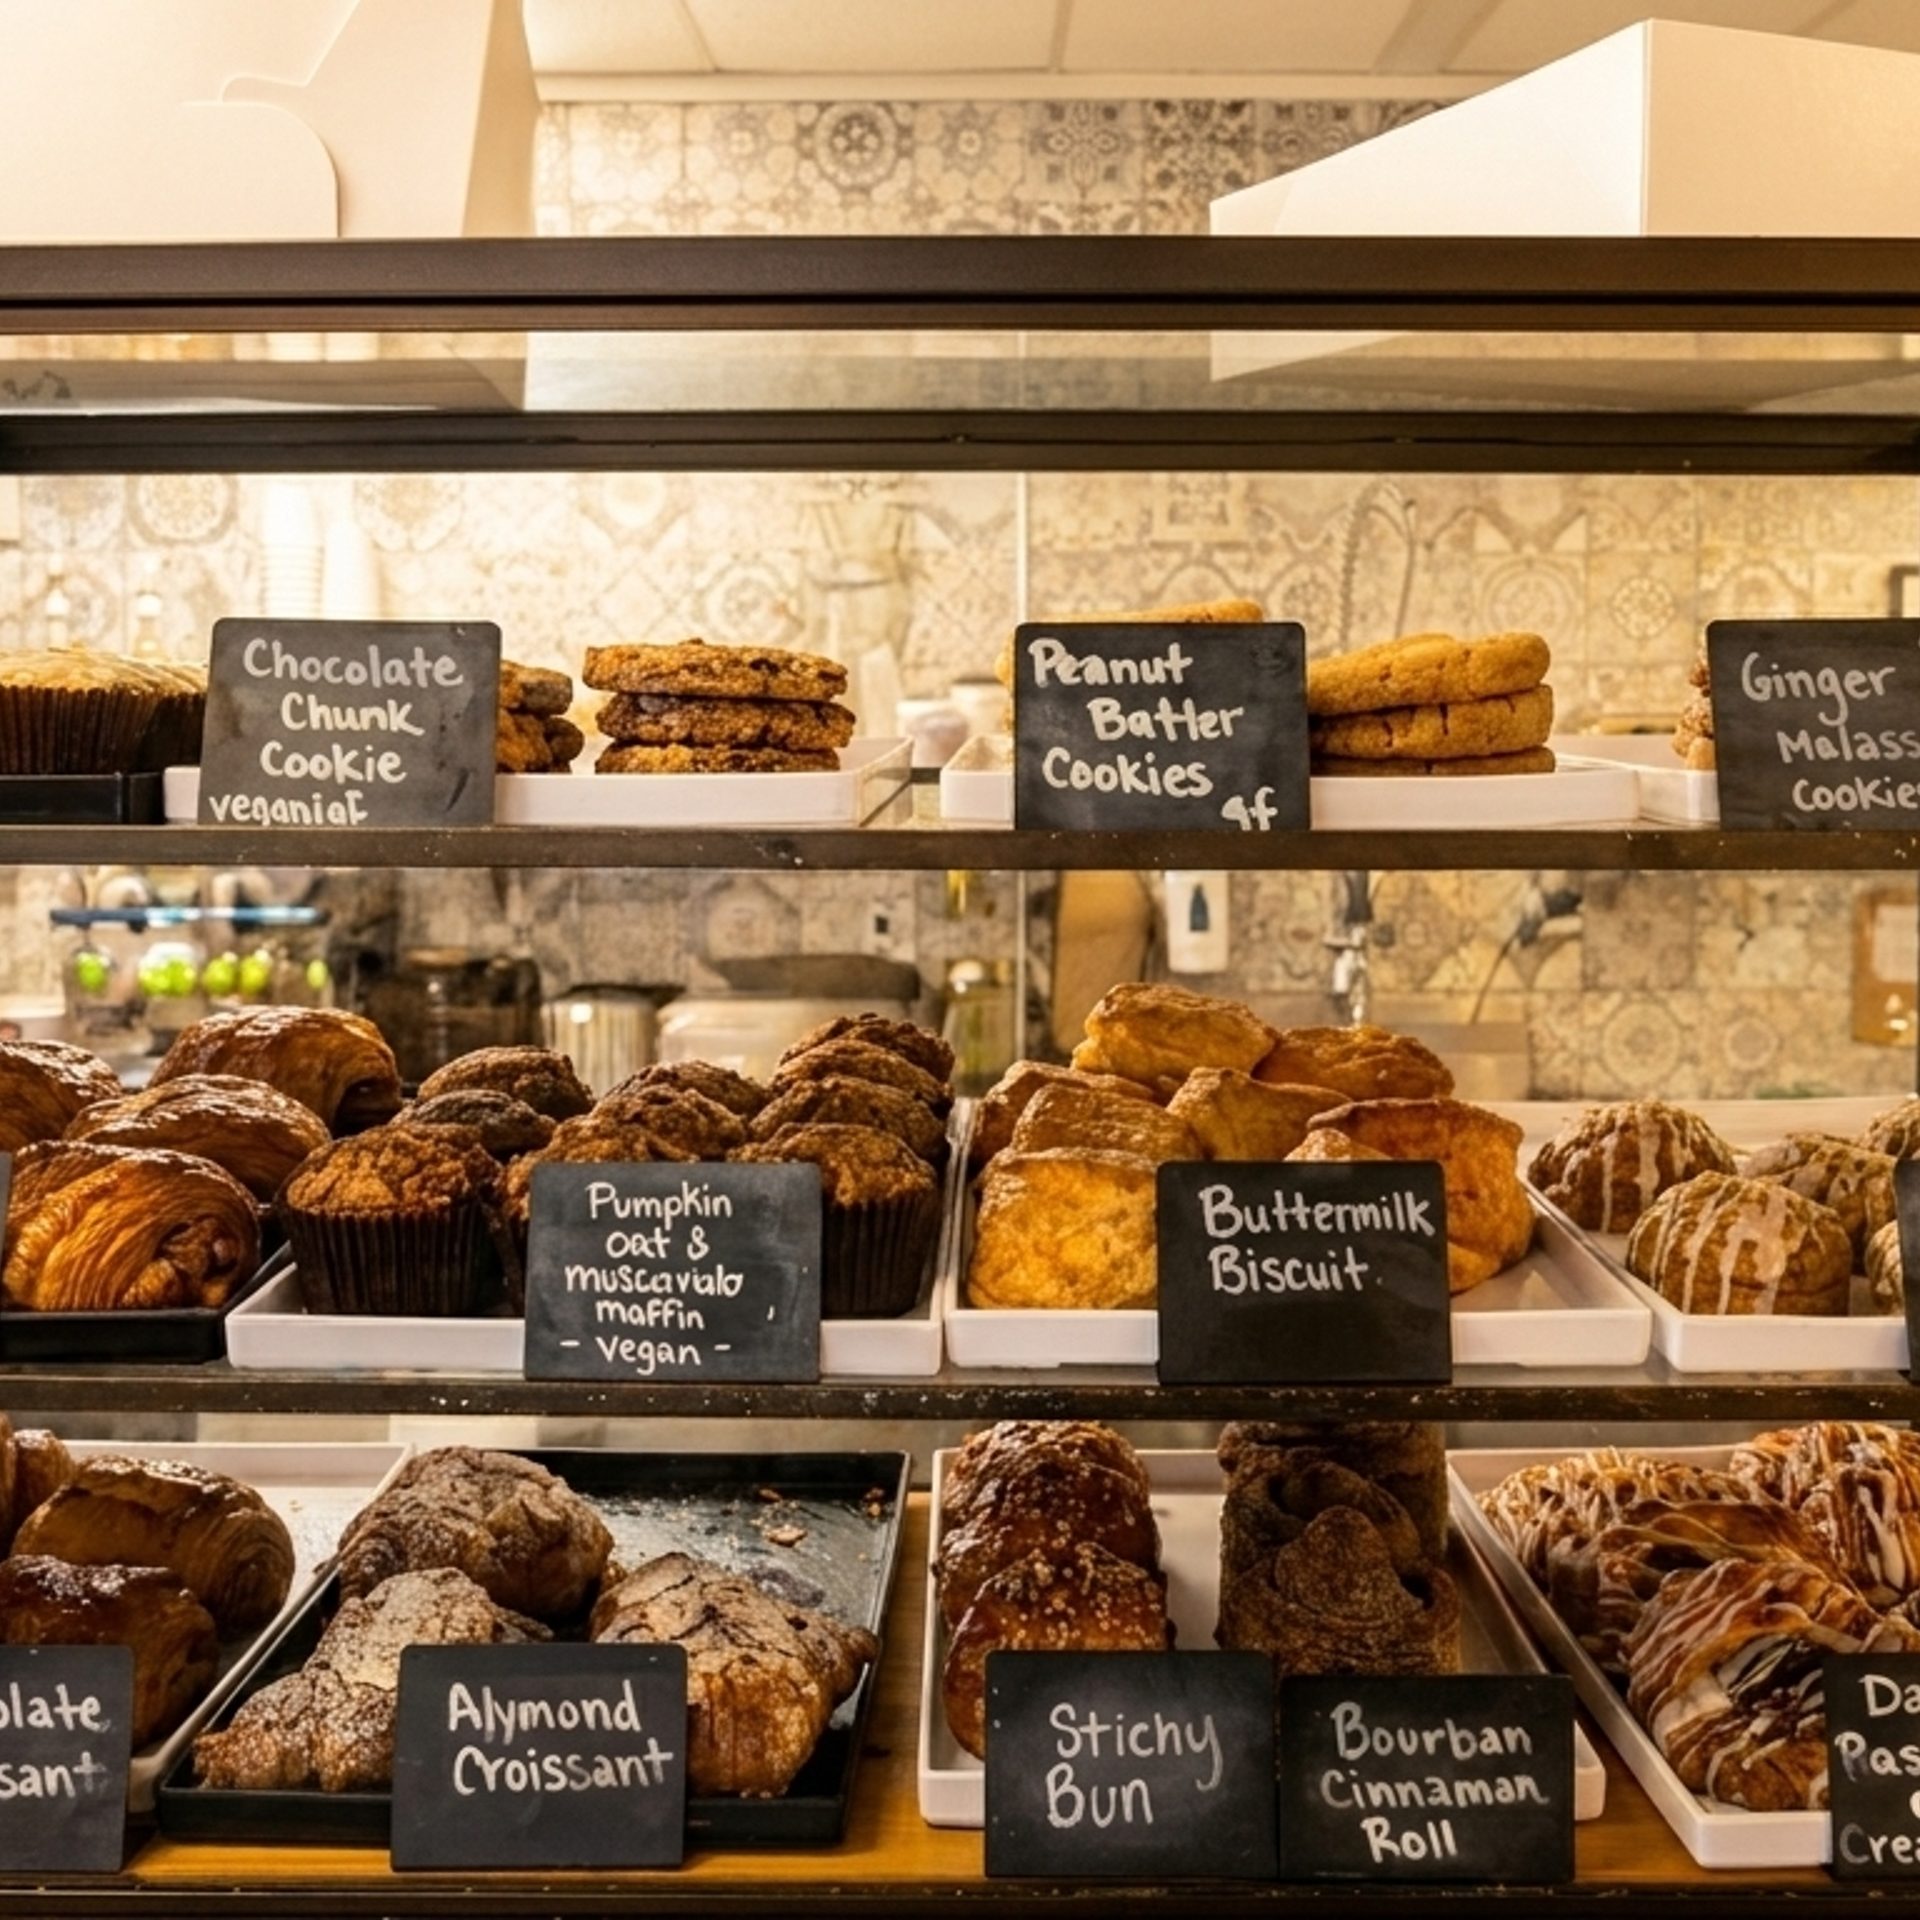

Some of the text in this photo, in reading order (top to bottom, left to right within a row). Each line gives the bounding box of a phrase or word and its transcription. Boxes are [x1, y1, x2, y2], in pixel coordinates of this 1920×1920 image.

[242, 637, 464, 689] Chocolate
[1027, 637, 1194, 688] Peanut
[280, 691, 426, 736] Chunk
[1741, 651, 1897, 726] Ginger
[259, 739, 408, 784] Cookie
[1041, 746, 1214, 797] Cookies
[1792, 776, 1920, 812] Cookie
[585, 1180, 733, 1231] Pumpkin
[1198, 1184, 1436, 1239] Buttermilk
[1207, 1244, 1369, 1296] Biscuit
[447, 1678, 642, 1746] Alymond
[1857, 1674, 1920, 1717] Da
[1049, 1702, 1224, 1792] Stichy
[1329, 1701, 1532, 1760] Bourban
[453, 1736, 674, 1796] Croissant
[1834, 1731, 1920, 1782] Pas
[1045, 1762, 1153, 1829] Bun
[1319, 1768, 1550, 1809] Cinnaman
[1359, 1815, 1458, 1864] Roll
[1839, 1822, 1920, 1864] Cre
